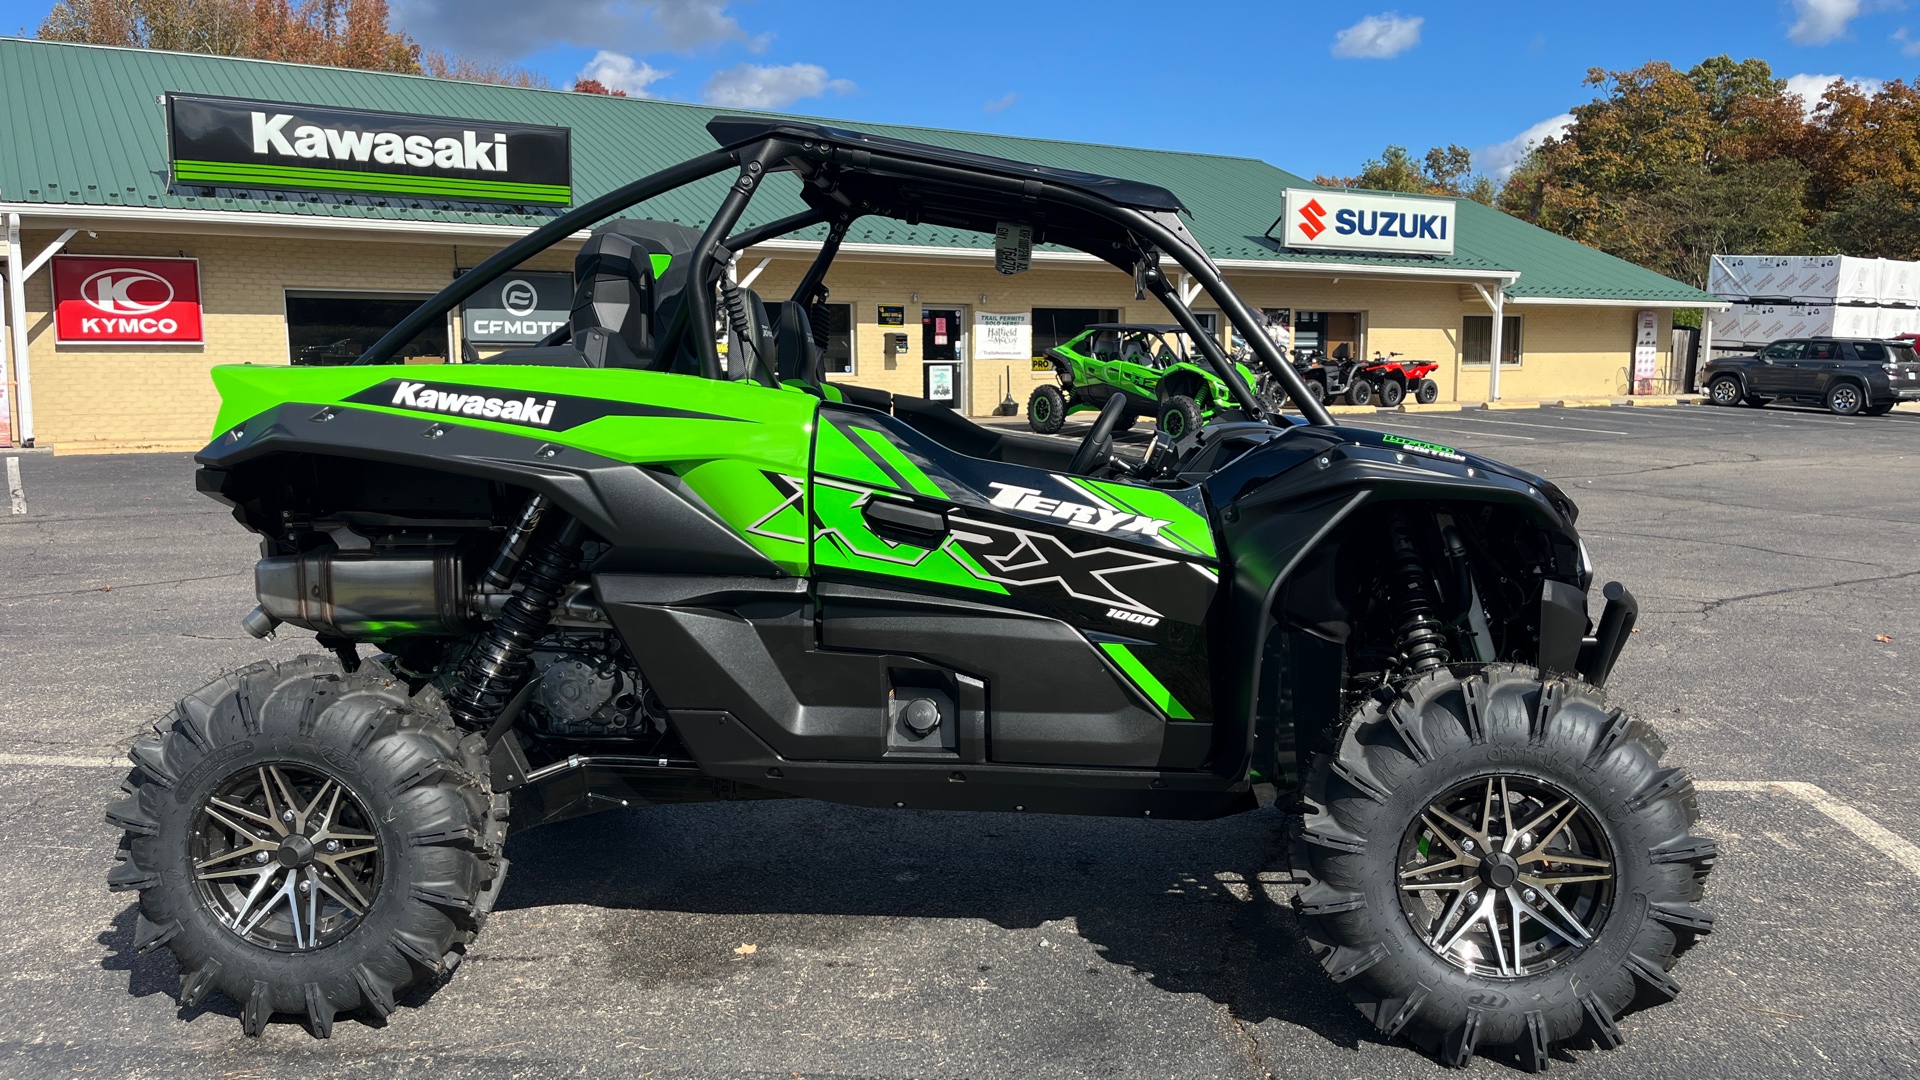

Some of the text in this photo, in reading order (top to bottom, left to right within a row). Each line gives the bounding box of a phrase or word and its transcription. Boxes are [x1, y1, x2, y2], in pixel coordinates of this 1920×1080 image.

[251, 111, 508, 172] Kawasaki
[1334, 208, 1448, 240] SUZUKI
[1001, 246, 1018, 275] T64704
[82, 317, 178, 334] KYMCO
[1033, 360, 1049, 368] PRO
[391, 381, 557, 425] Kawasaki
[1105, 607, 1160, 627] 1000
